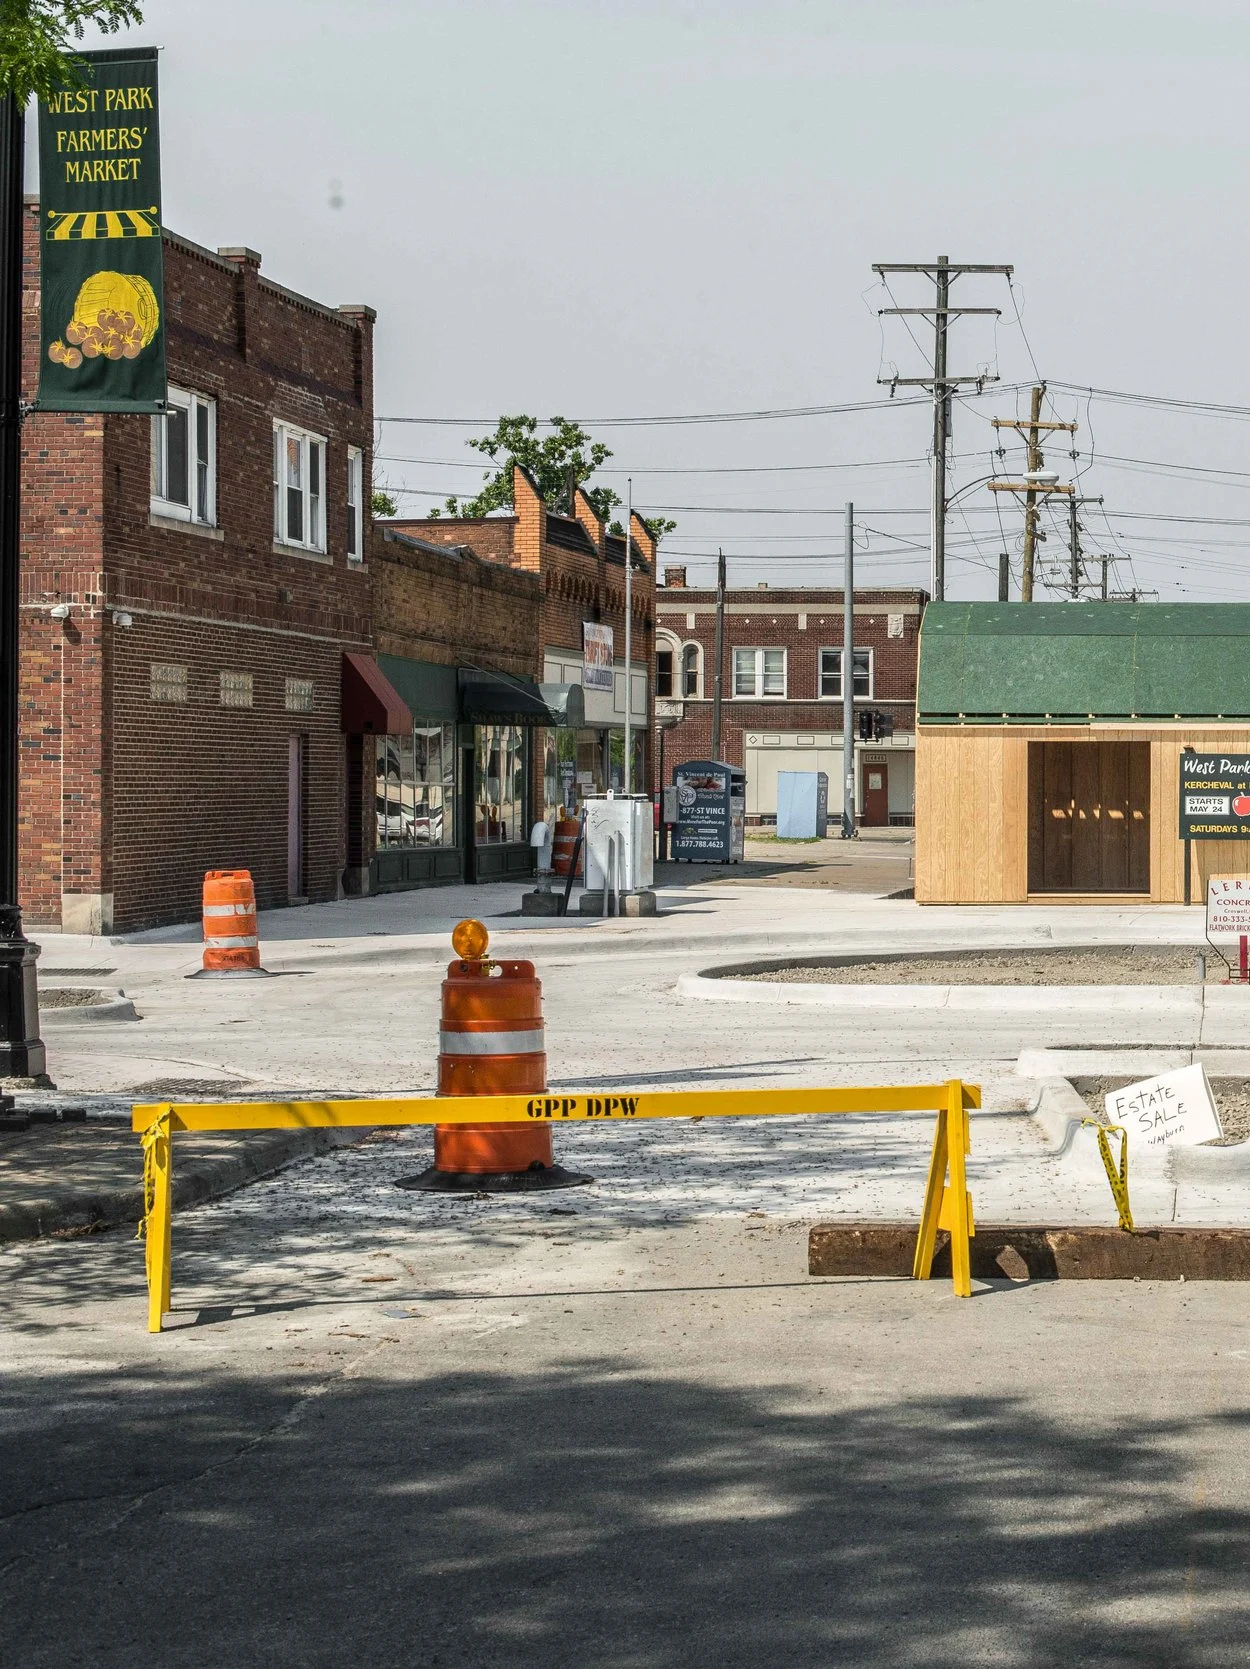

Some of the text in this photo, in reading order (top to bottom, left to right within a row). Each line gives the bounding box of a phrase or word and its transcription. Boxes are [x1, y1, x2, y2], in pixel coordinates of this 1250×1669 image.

[48, 86, 154, 114] WEST PARK
[56, 126, 148, 153] FARMERS'
[65, 158, 142, 183] MARKET
[1184, 759, 1216, 774] West
[1184, 781, 1234, 789] KERCHEVAL
[680, 807, 726, 815] -877-ST VINCE
[1190, 825, 1238, 833] SATURDAYS
[1209, 924, 1236, 932] FLATWORK
[1236, 924, 1250, 932] BRICK
[527, 1097, 640, 1118] GPP DPW
[1138, 1102, 1187, 1133] SALE
